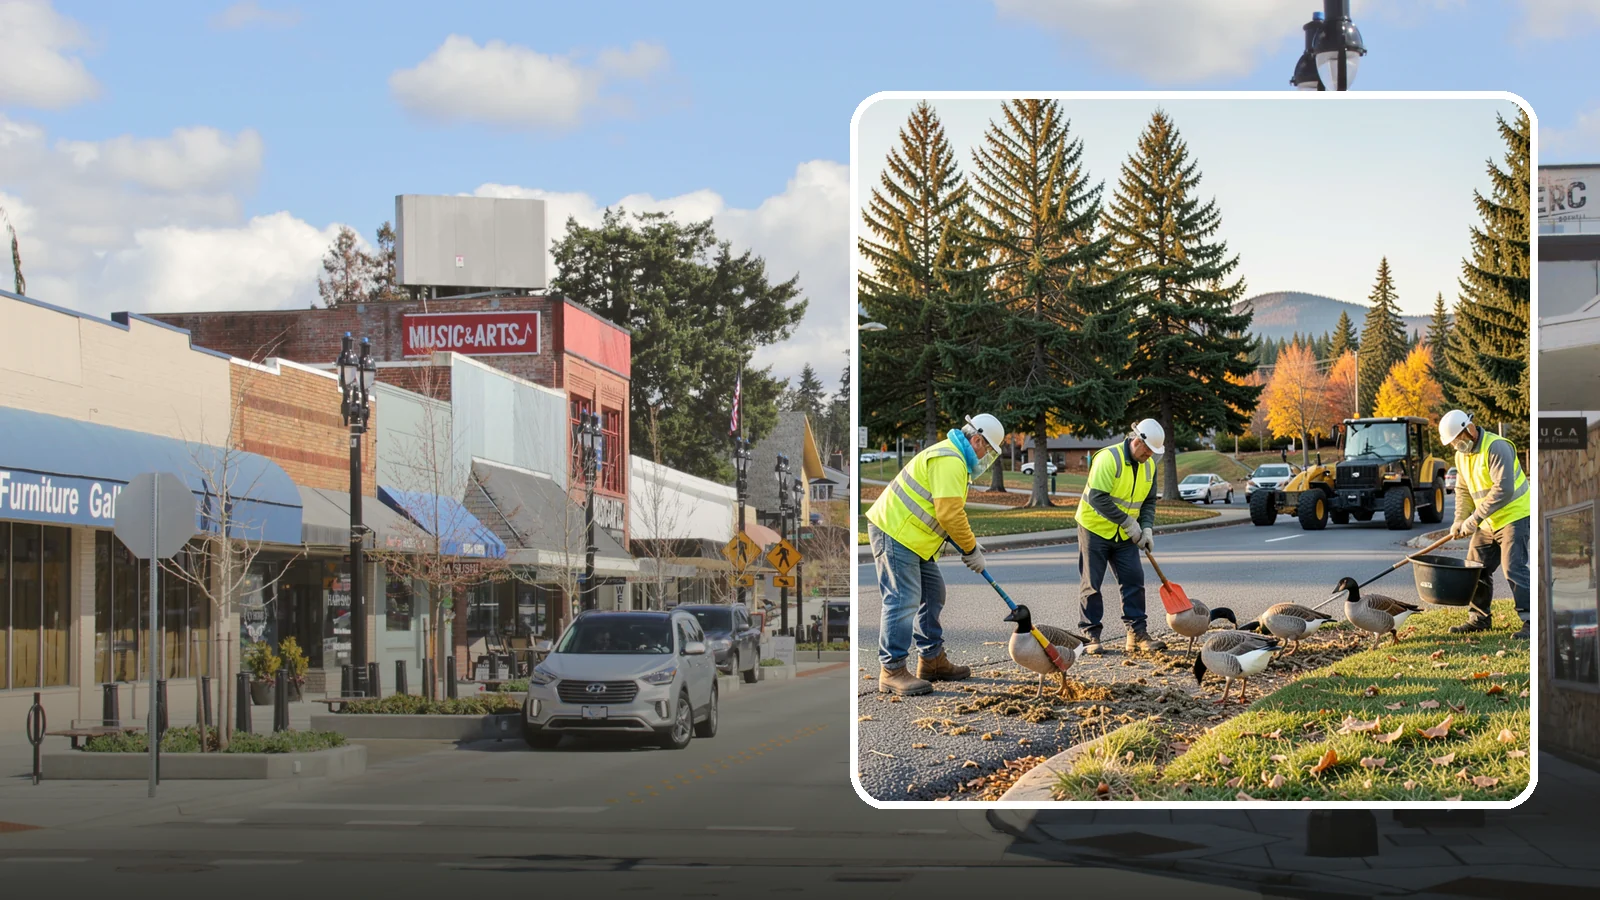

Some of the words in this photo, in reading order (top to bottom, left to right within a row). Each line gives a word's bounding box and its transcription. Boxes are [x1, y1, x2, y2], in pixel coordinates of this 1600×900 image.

[408, 322, 519, 349] MUSIC&ARTS
[0, 471, 79, 515] Furniture
[89, 482, 122, 519] Gal
[453, 563, 479, 574] SUSHI
